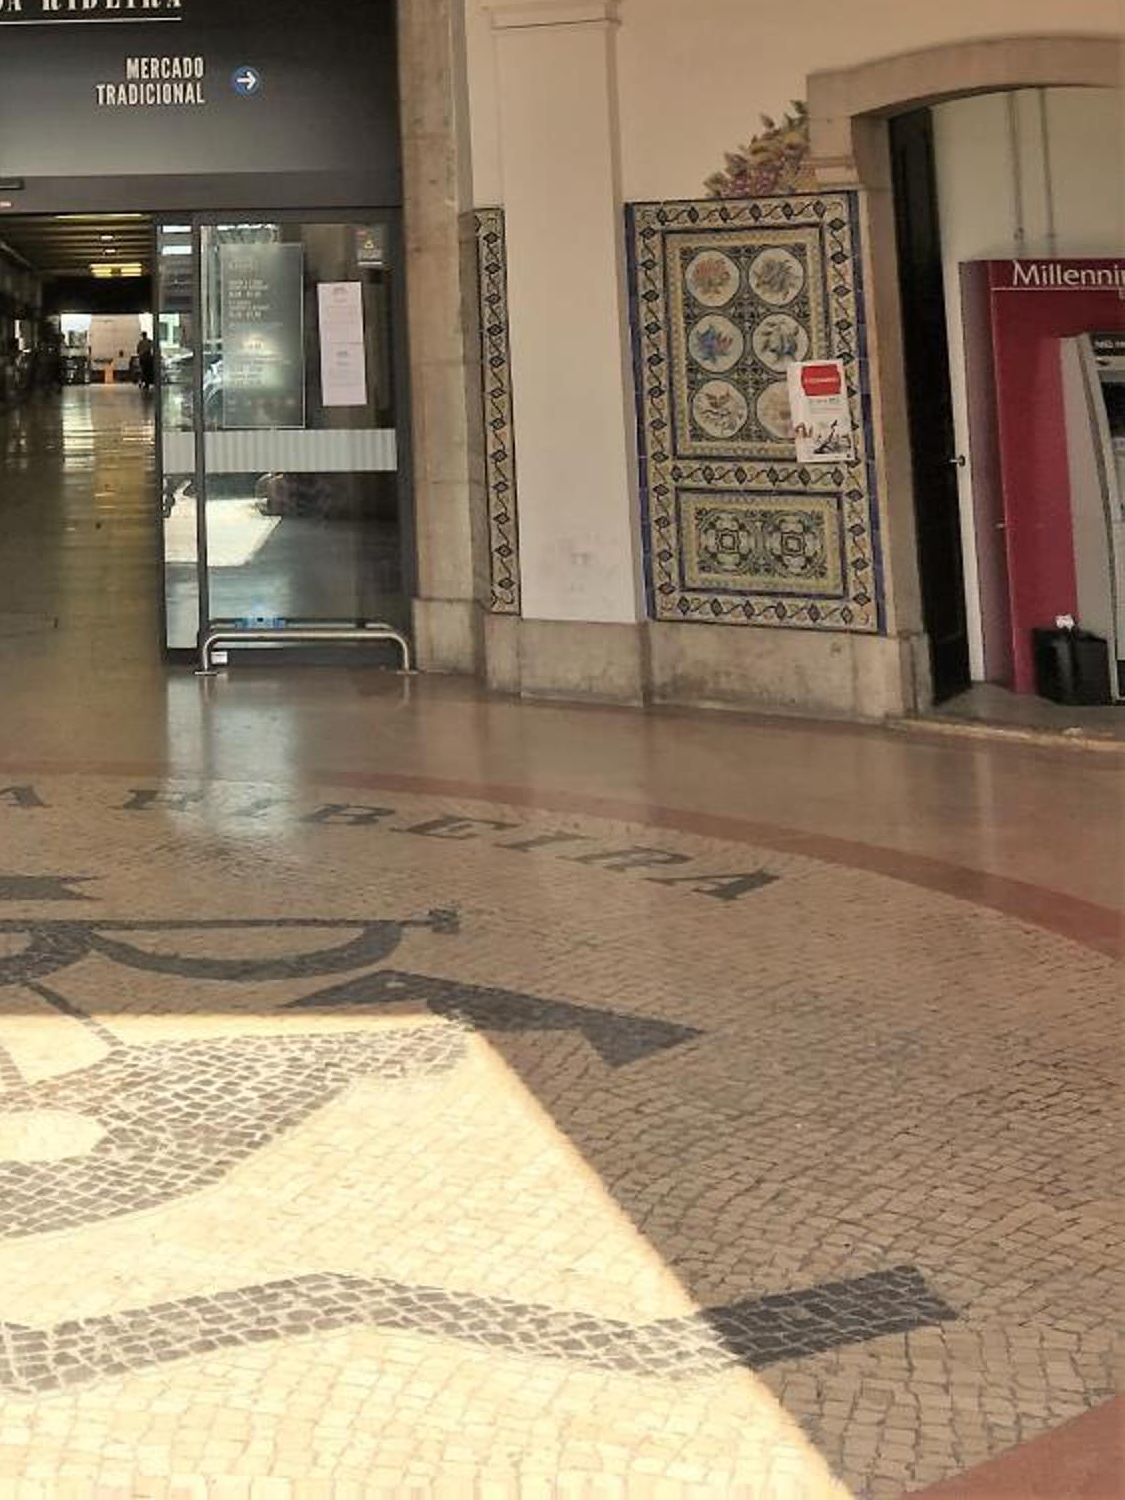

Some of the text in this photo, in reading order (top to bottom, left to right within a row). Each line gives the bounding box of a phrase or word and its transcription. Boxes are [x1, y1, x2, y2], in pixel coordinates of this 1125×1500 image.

[126, 56, 204, 79] MERCADO
[96, 83, 206, 105] TRADICIONAL
[1012, 259, 1125, 286] Millenni
